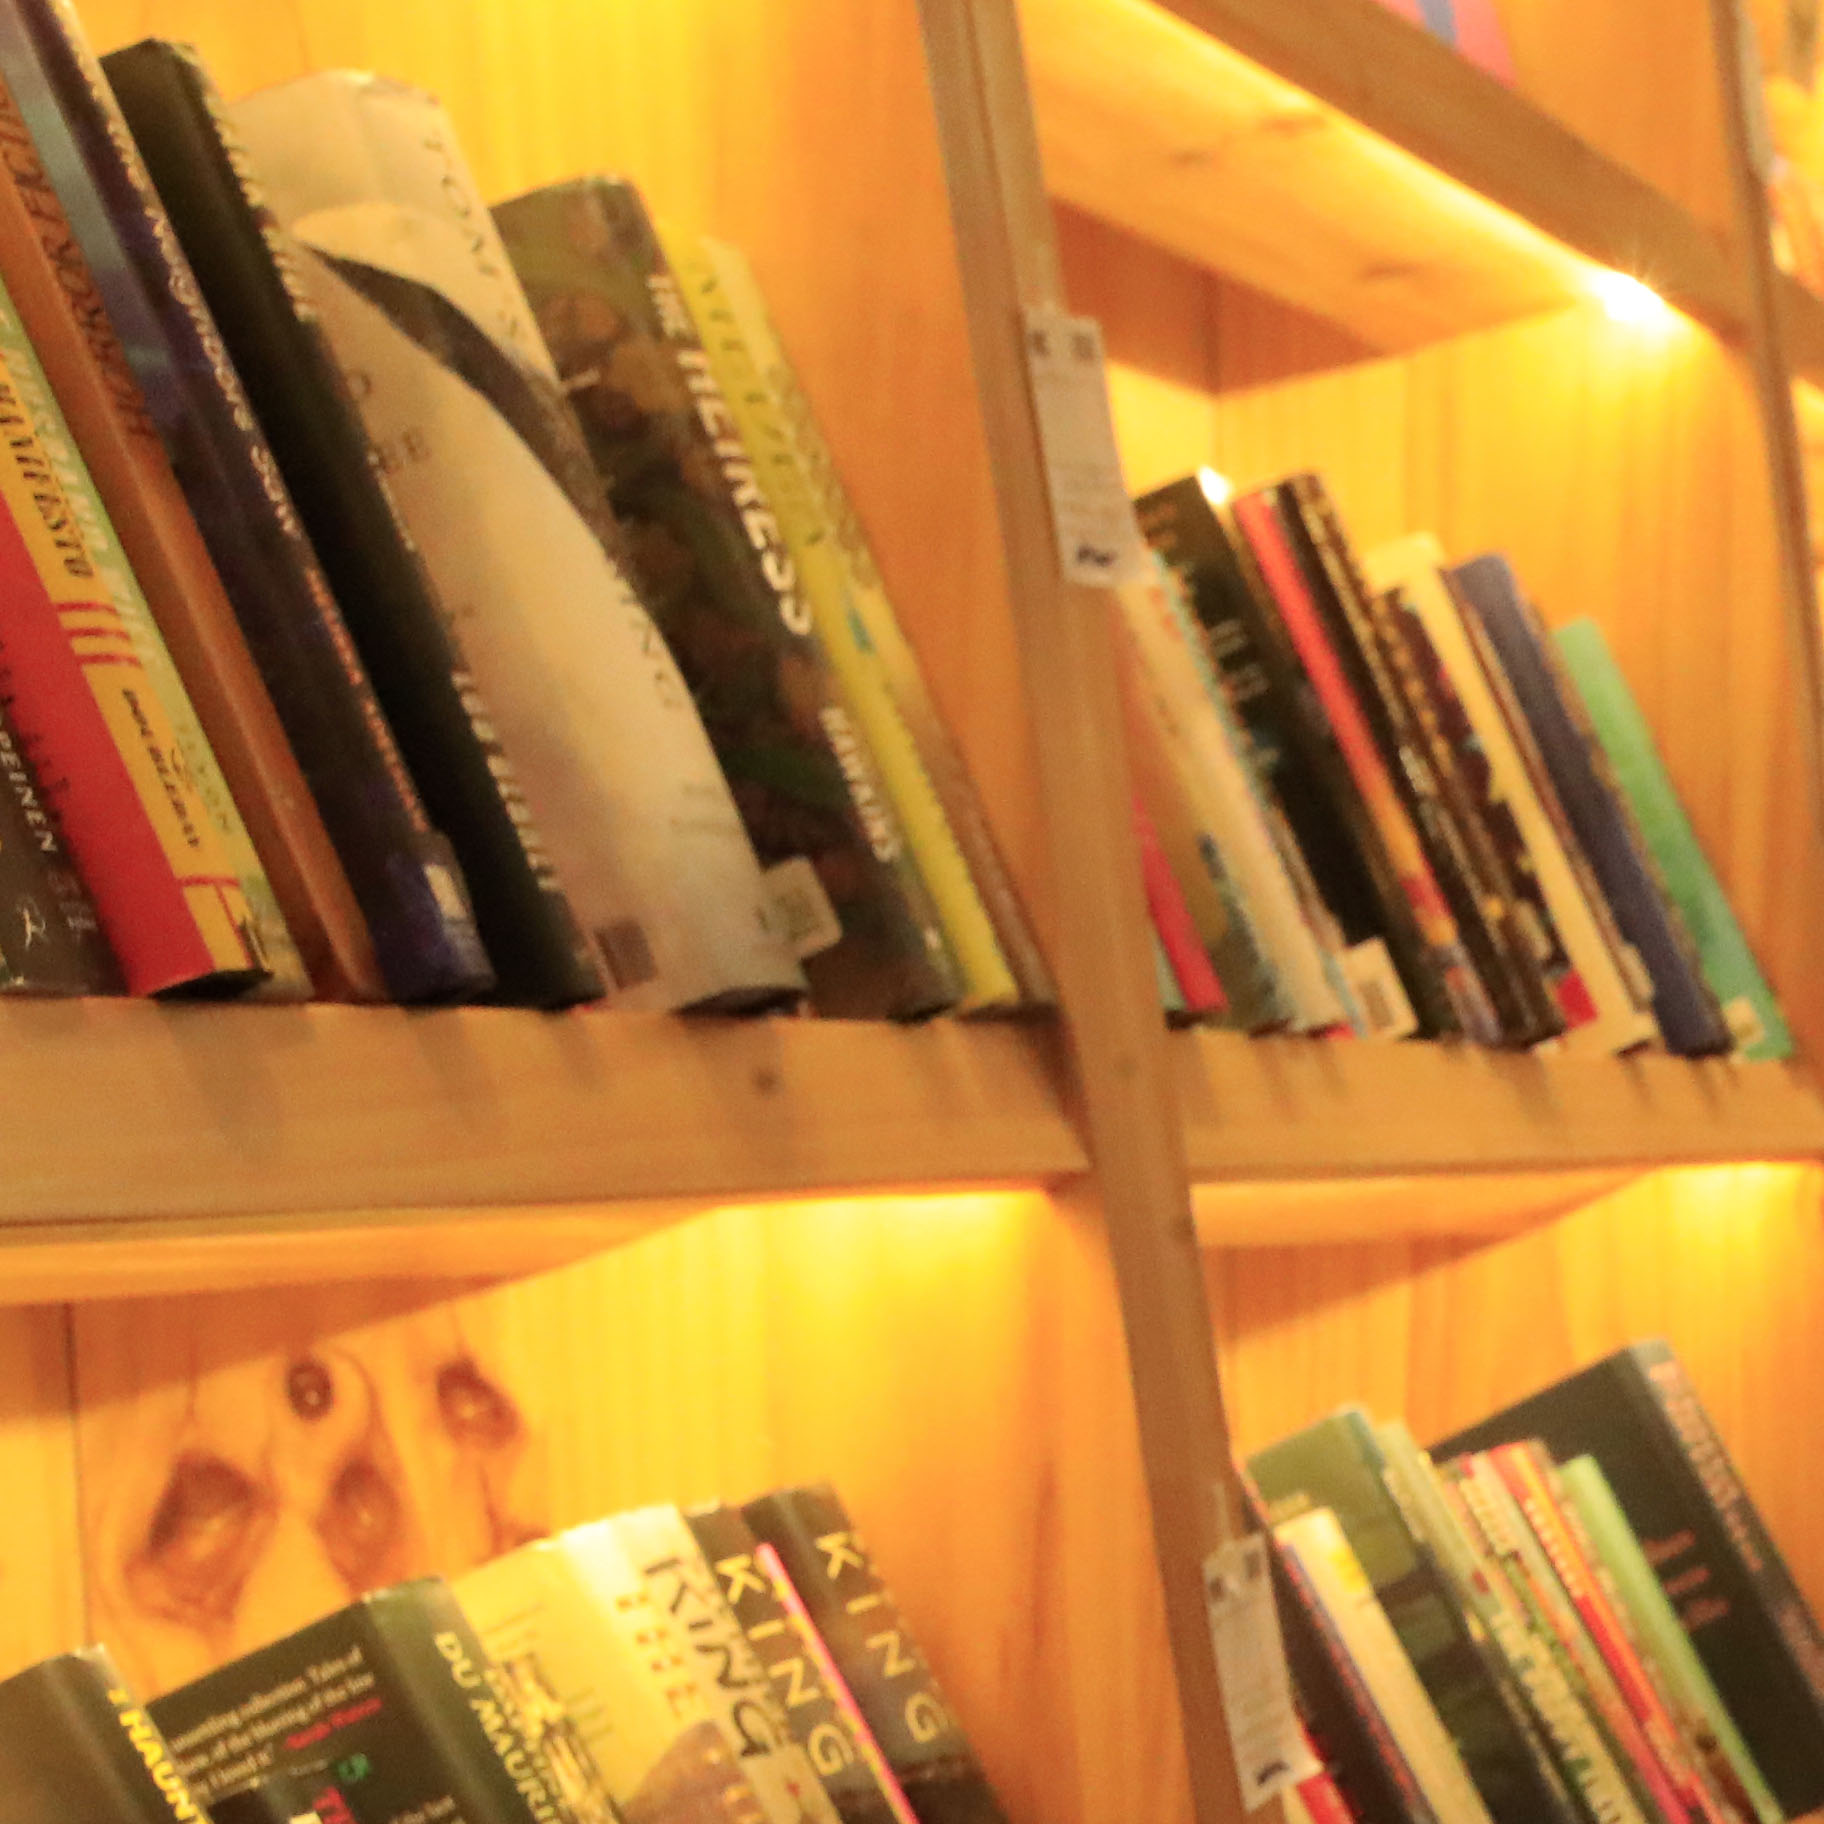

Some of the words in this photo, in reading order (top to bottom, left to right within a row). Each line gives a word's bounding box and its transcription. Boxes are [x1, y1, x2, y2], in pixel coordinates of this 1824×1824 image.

[647, 274, 688, 343] THE
[682, 347, 812, 637] HEIRESS
[821, 706, 896, 862] HAWKINS
[427, 1626, 482, 1693] DU
[639, 1549, 785, 1768] KING
[708, 1548, 859, 1783] KING
[809, 1524, 955, 1748] KING
